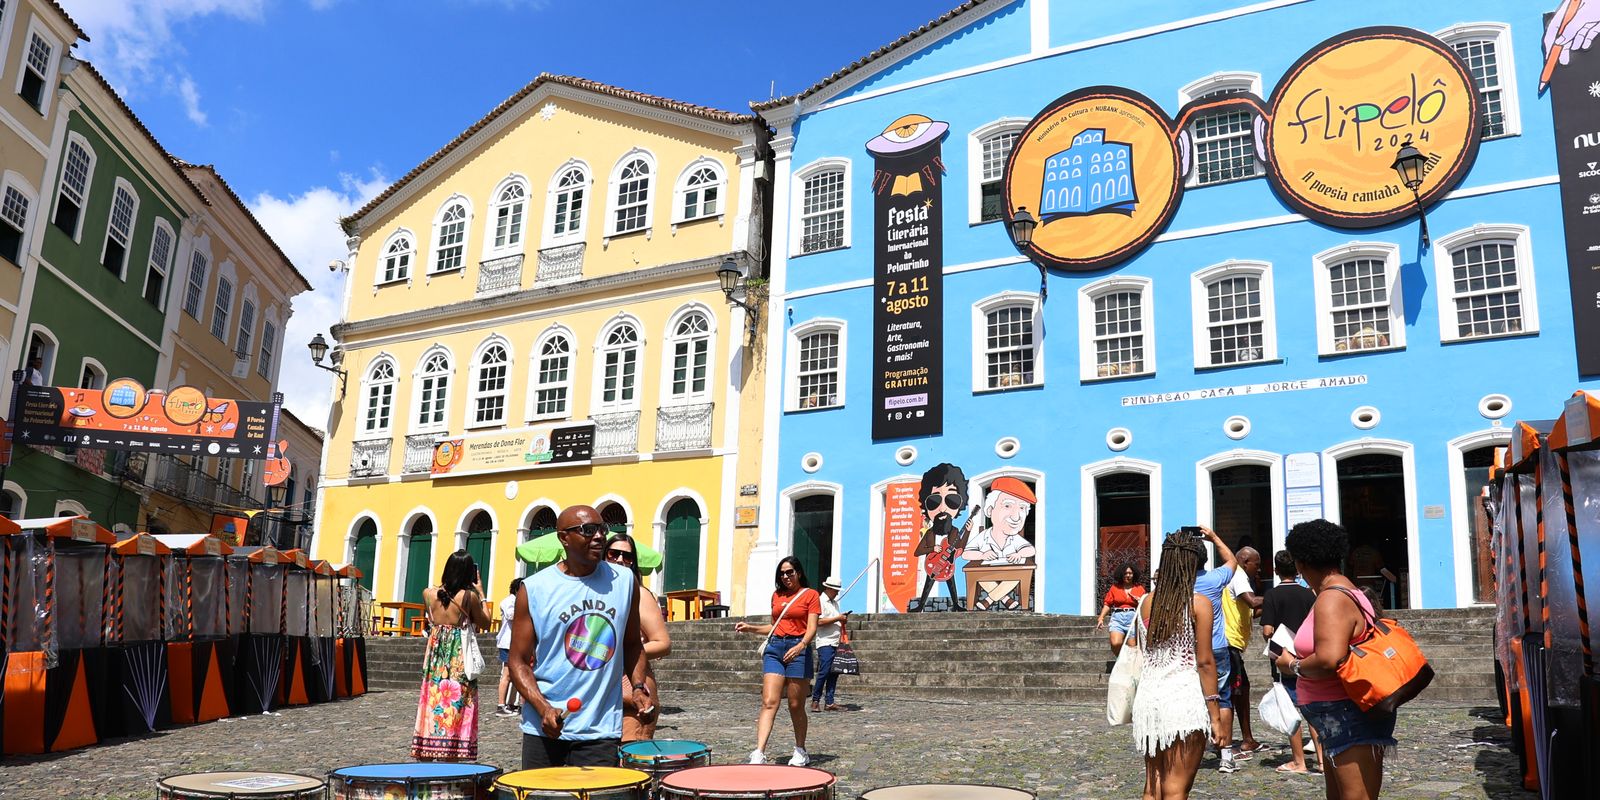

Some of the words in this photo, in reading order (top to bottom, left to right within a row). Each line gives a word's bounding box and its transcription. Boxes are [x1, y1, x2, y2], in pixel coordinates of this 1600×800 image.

[1037, 122, 1060, 142] Ministério
[1068, 108, 1088, 118] Cultura
[1374, 129, 1429, 151] 2024
[1309, 179, 1348, 201] poesia
[1353, 185, 1400, 202] cantada
[1423, 152, 1442, 176] aul
[888, 204, 928, 227] Festa
[888, 224, 928, 241] Literária
[888, 238, 928, 252] Internacional
[904, 252, 912, 260] do
[887, 259, 929, 274] Pelourinho
[887, 281, 896, 296] 7
[899, 284, 907, 294] a
[911, 276, 928, 293] 11
[887, 295, 928, 314] agosto
[887, 321, 922, 332] Literatura,
[887, 334, 903, 342] Arte,
[887, 340, 929, 352] Gastronomia
[895, 352, 913, 361] mais!
[885, 367, 928, 379] Programação
[885, 377, 928, 389] GRATUITA
[1200, 388, 1234, 398] CASA
[1264, 381, 1308, 392] JORGE
[1320, 375, 1366, 387] AMADO
[558, 600, 617, 624] BANDA
